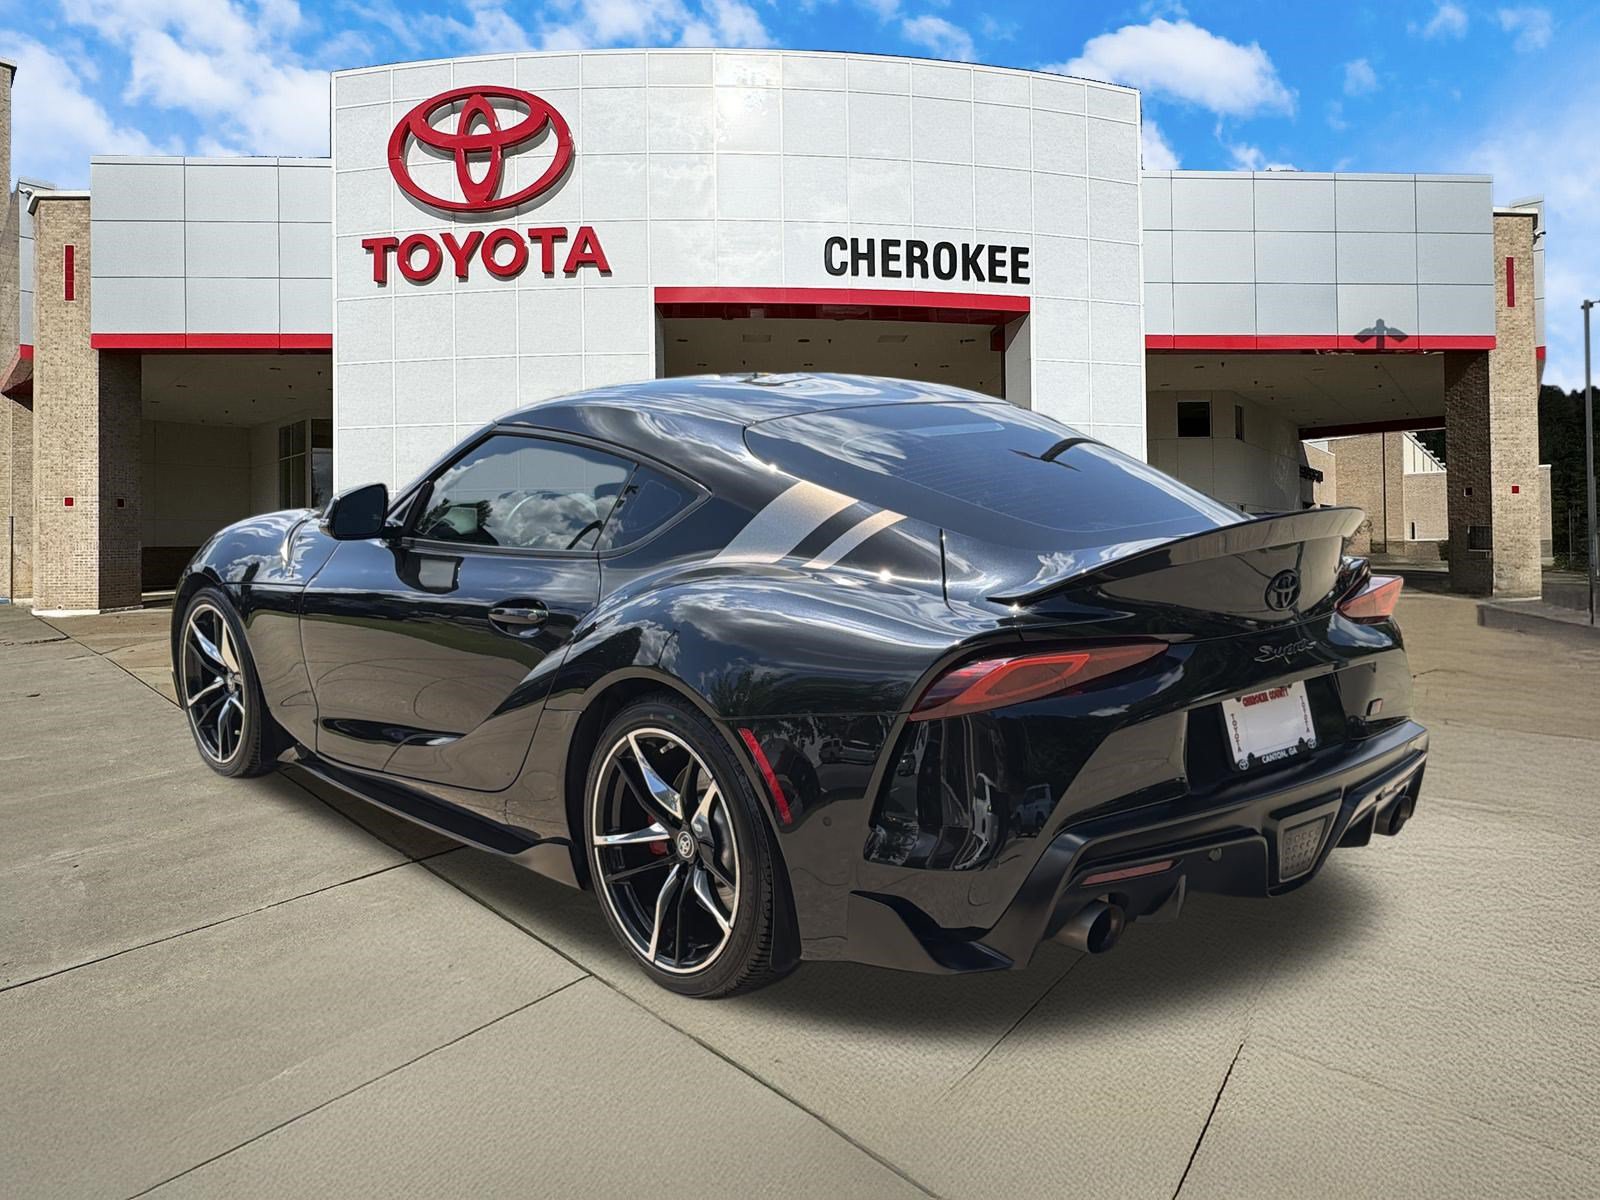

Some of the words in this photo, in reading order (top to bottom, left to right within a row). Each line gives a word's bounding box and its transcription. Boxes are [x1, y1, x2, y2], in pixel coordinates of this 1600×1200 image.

[362, 226, 612, 284] TOYOTA
[824, 236, 1031, 285] CHEROKEE
[1254, 638, 1317, 664] Supra
[1231, 713, 1242, 752] TOYOTA
[1300, 695, 1310, 733] TOYOTA
[1288, 746, 1298, 756] GA
